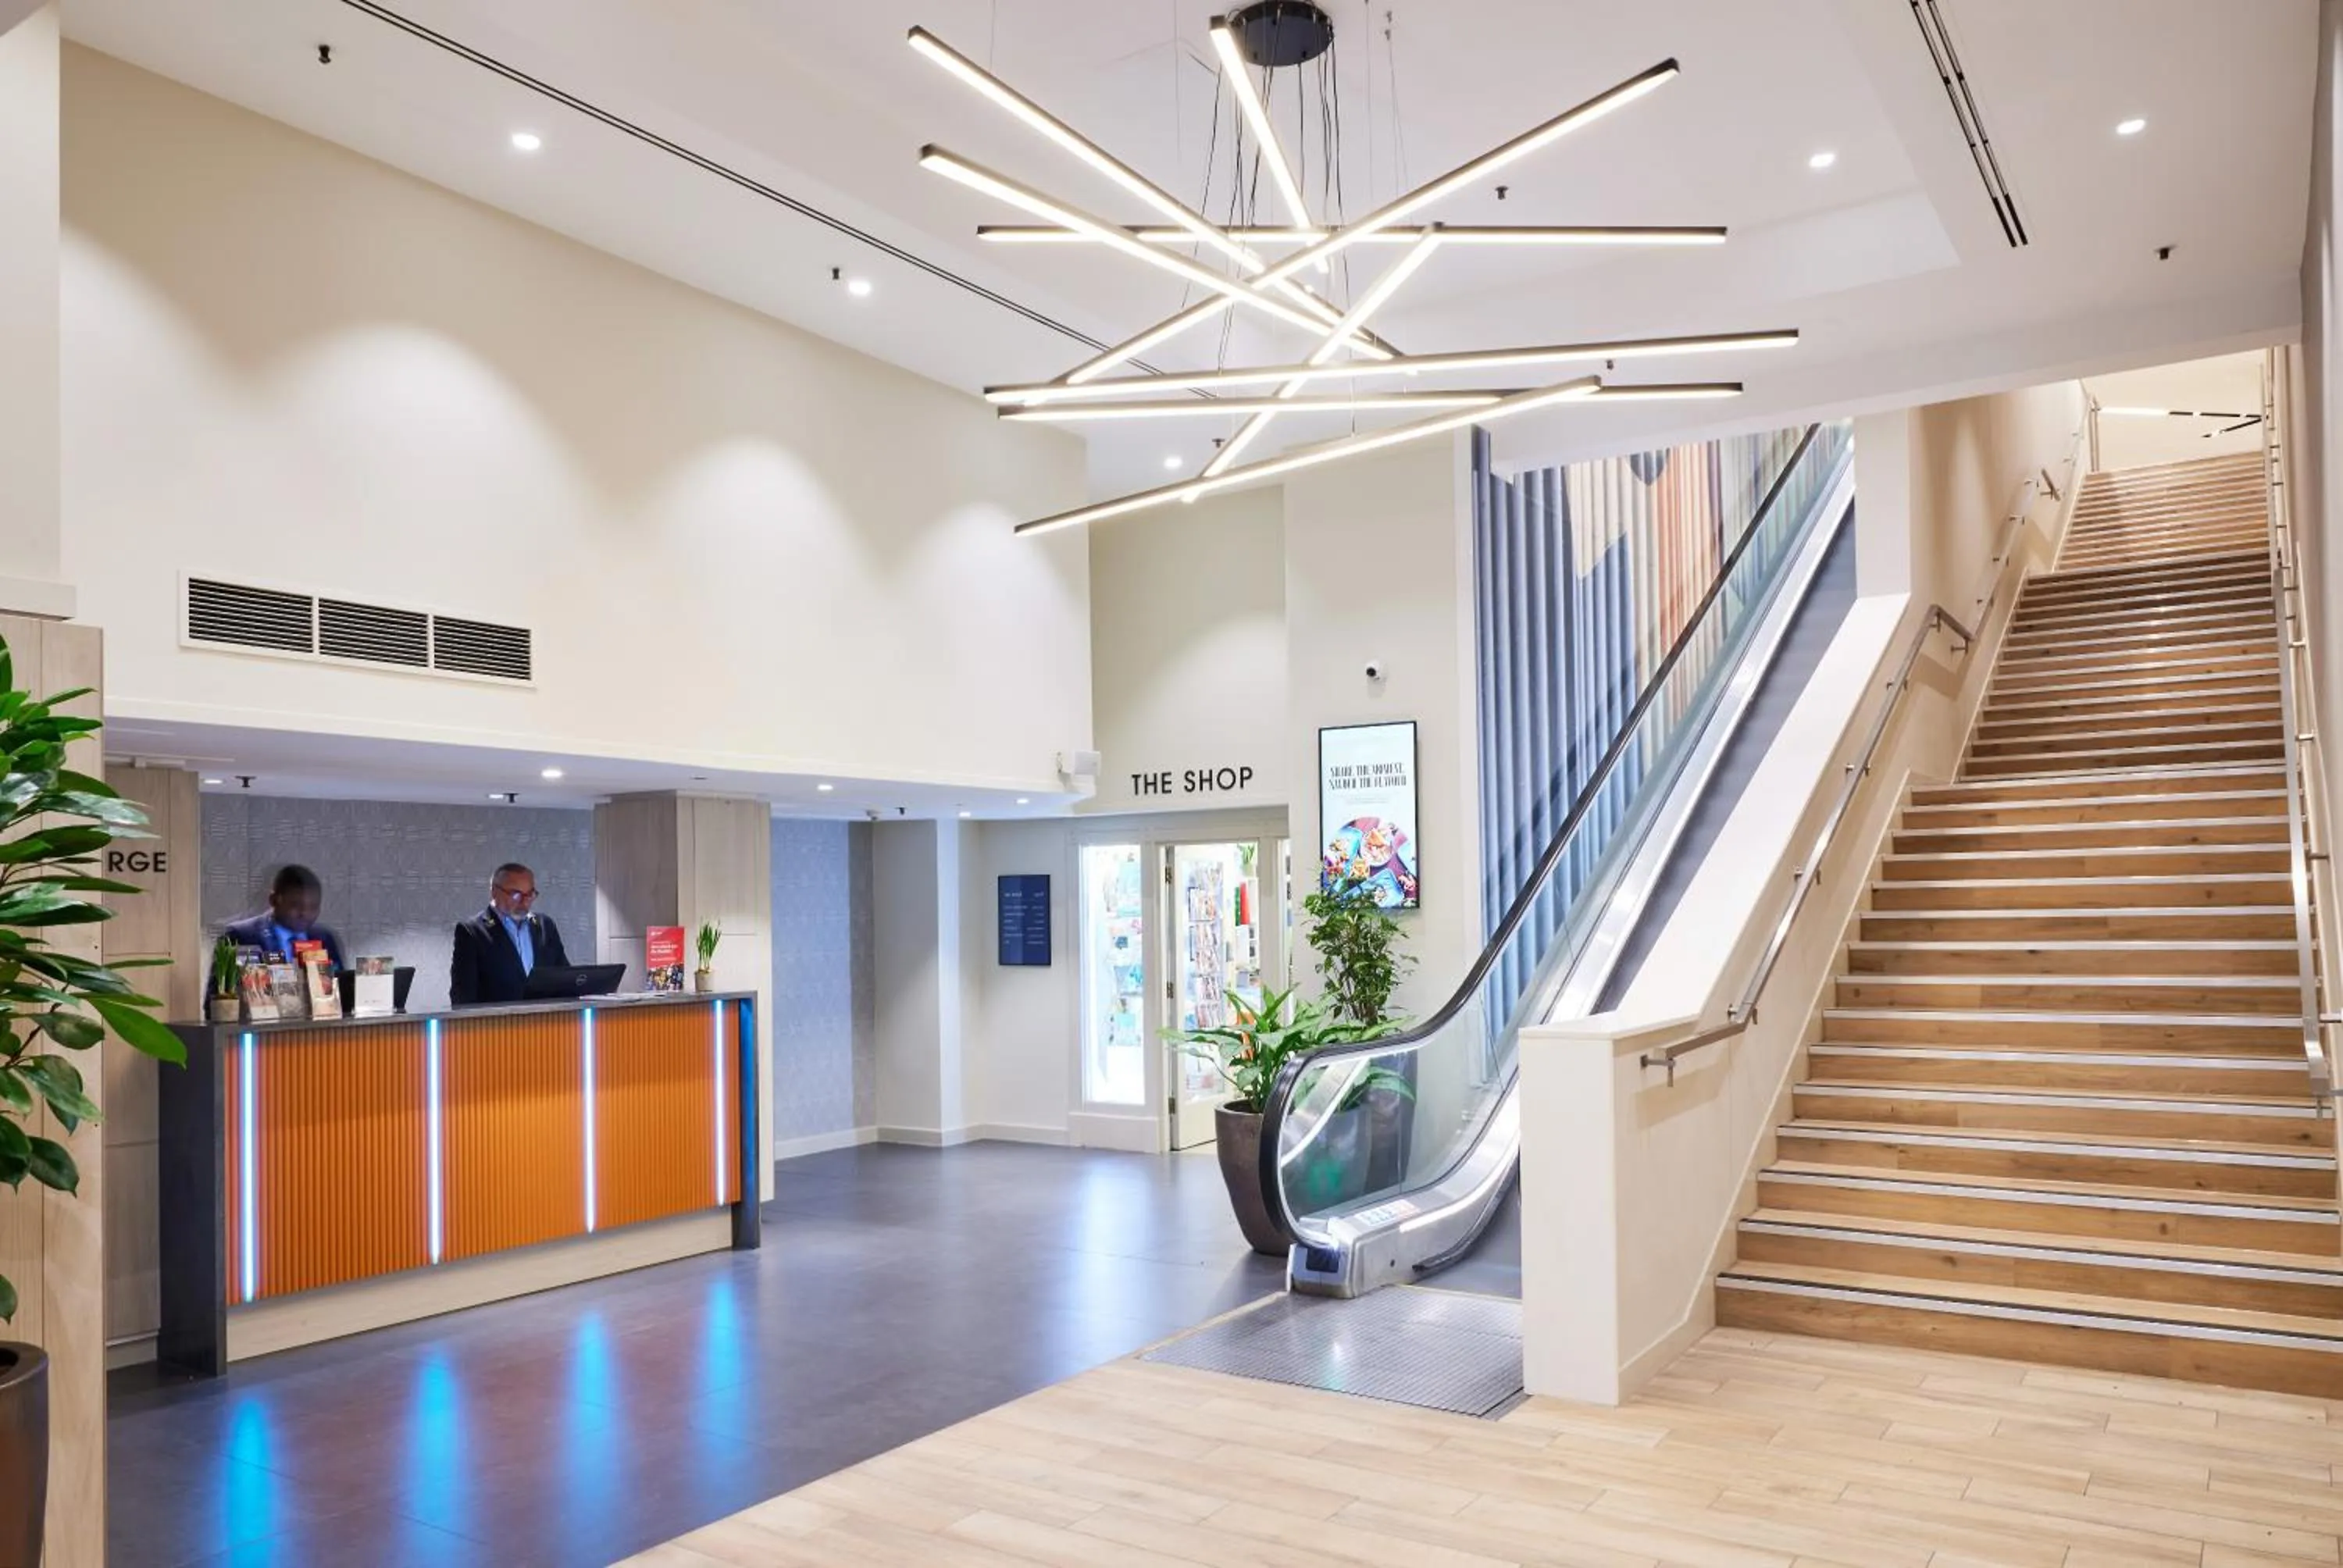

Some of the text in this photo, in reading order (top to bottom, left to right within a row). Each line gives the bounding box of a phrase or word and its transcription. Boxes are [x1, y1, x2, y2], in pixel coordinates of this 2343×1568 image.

[1132, 766, 1253, 796] THE SHOP
[108, 850, 166, 872] RGE
